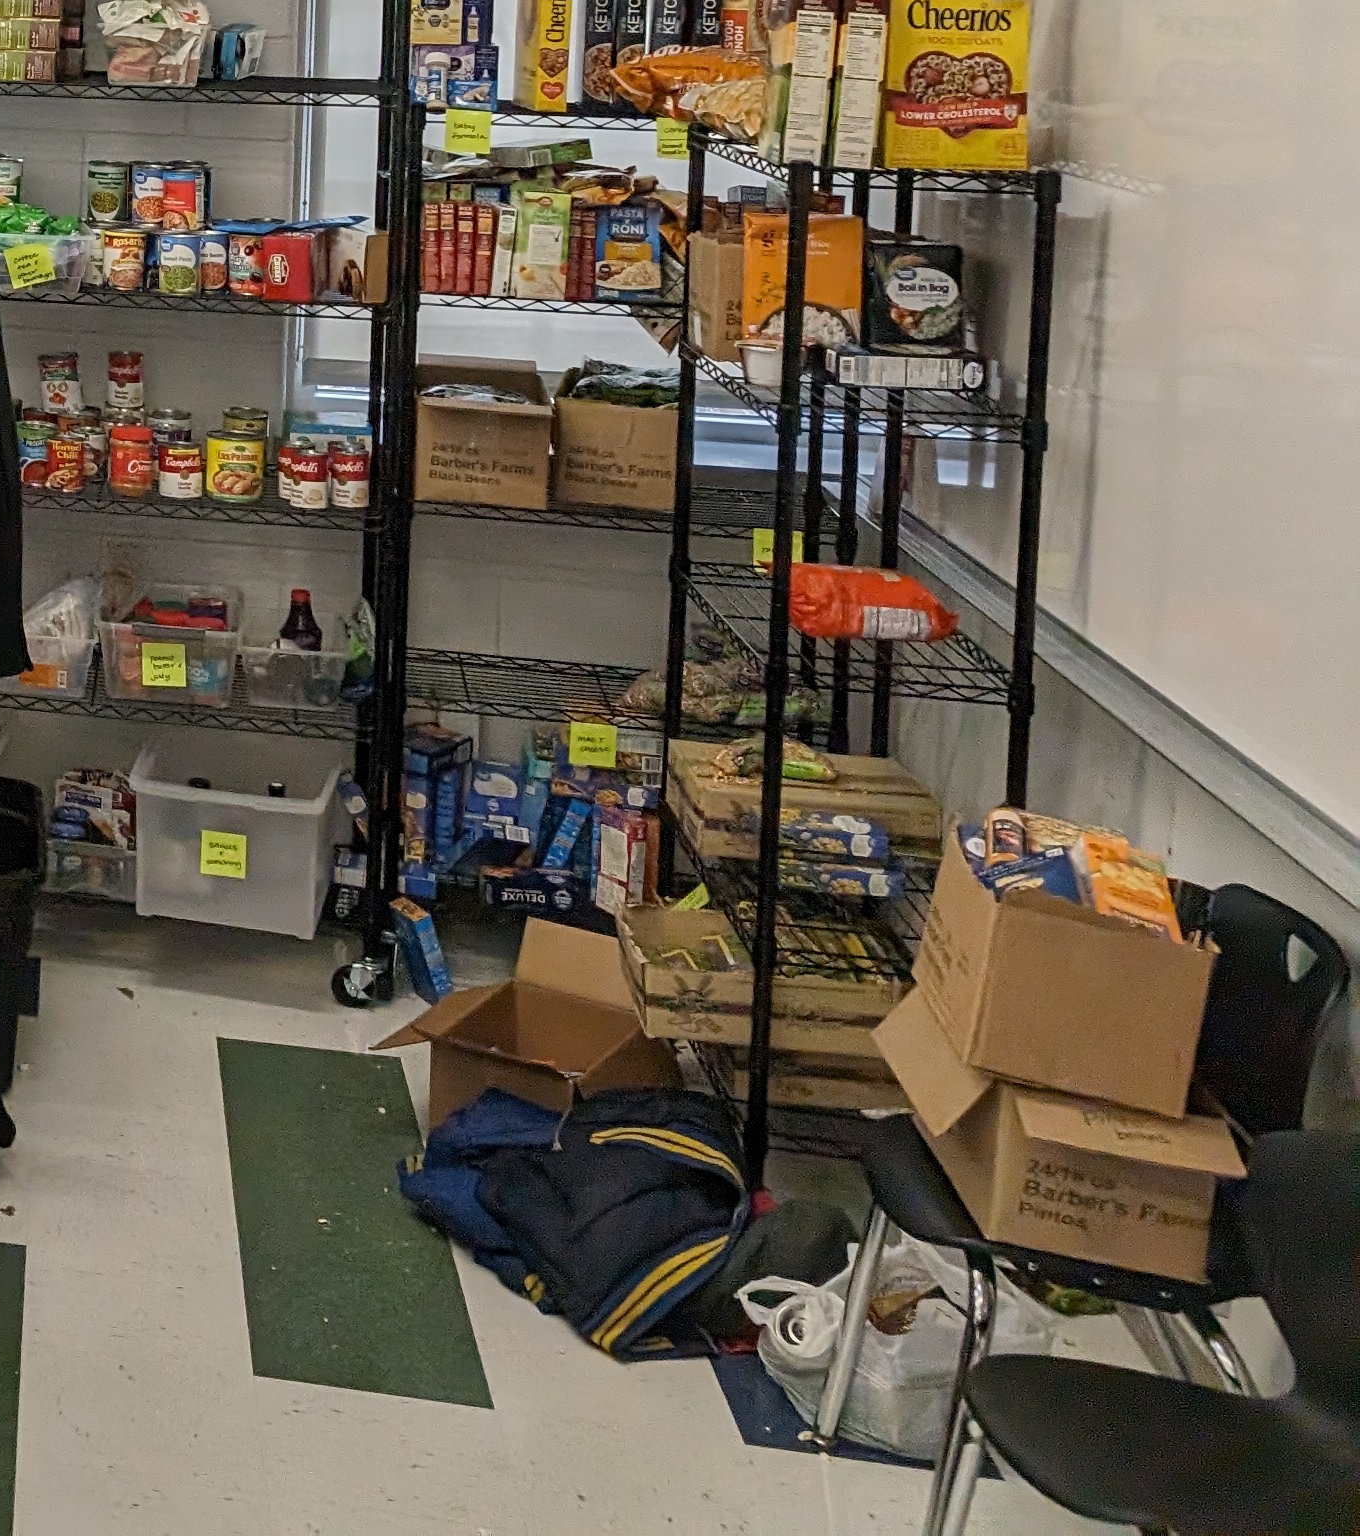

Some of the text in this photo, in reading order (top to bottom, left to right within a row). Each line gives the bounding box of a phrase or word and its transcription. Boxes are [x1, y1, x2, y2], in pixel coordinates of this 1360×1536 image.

[906, 0, 1012, 32] Cheerios
[900, 108, 1002, 120] LOWER CHOLESTEROL
[610, 208, 644, 218] PASTA
[612, 224, 644, 234] RONI
[898, 282, 950, 294] Boil in Bag
[492, 460, 535, 476] Farms
[429, 469, 461, 482] Black
[500, 891, 546, 904] DELUXE
[1019, 1200, 1088, 1231] Pintos
